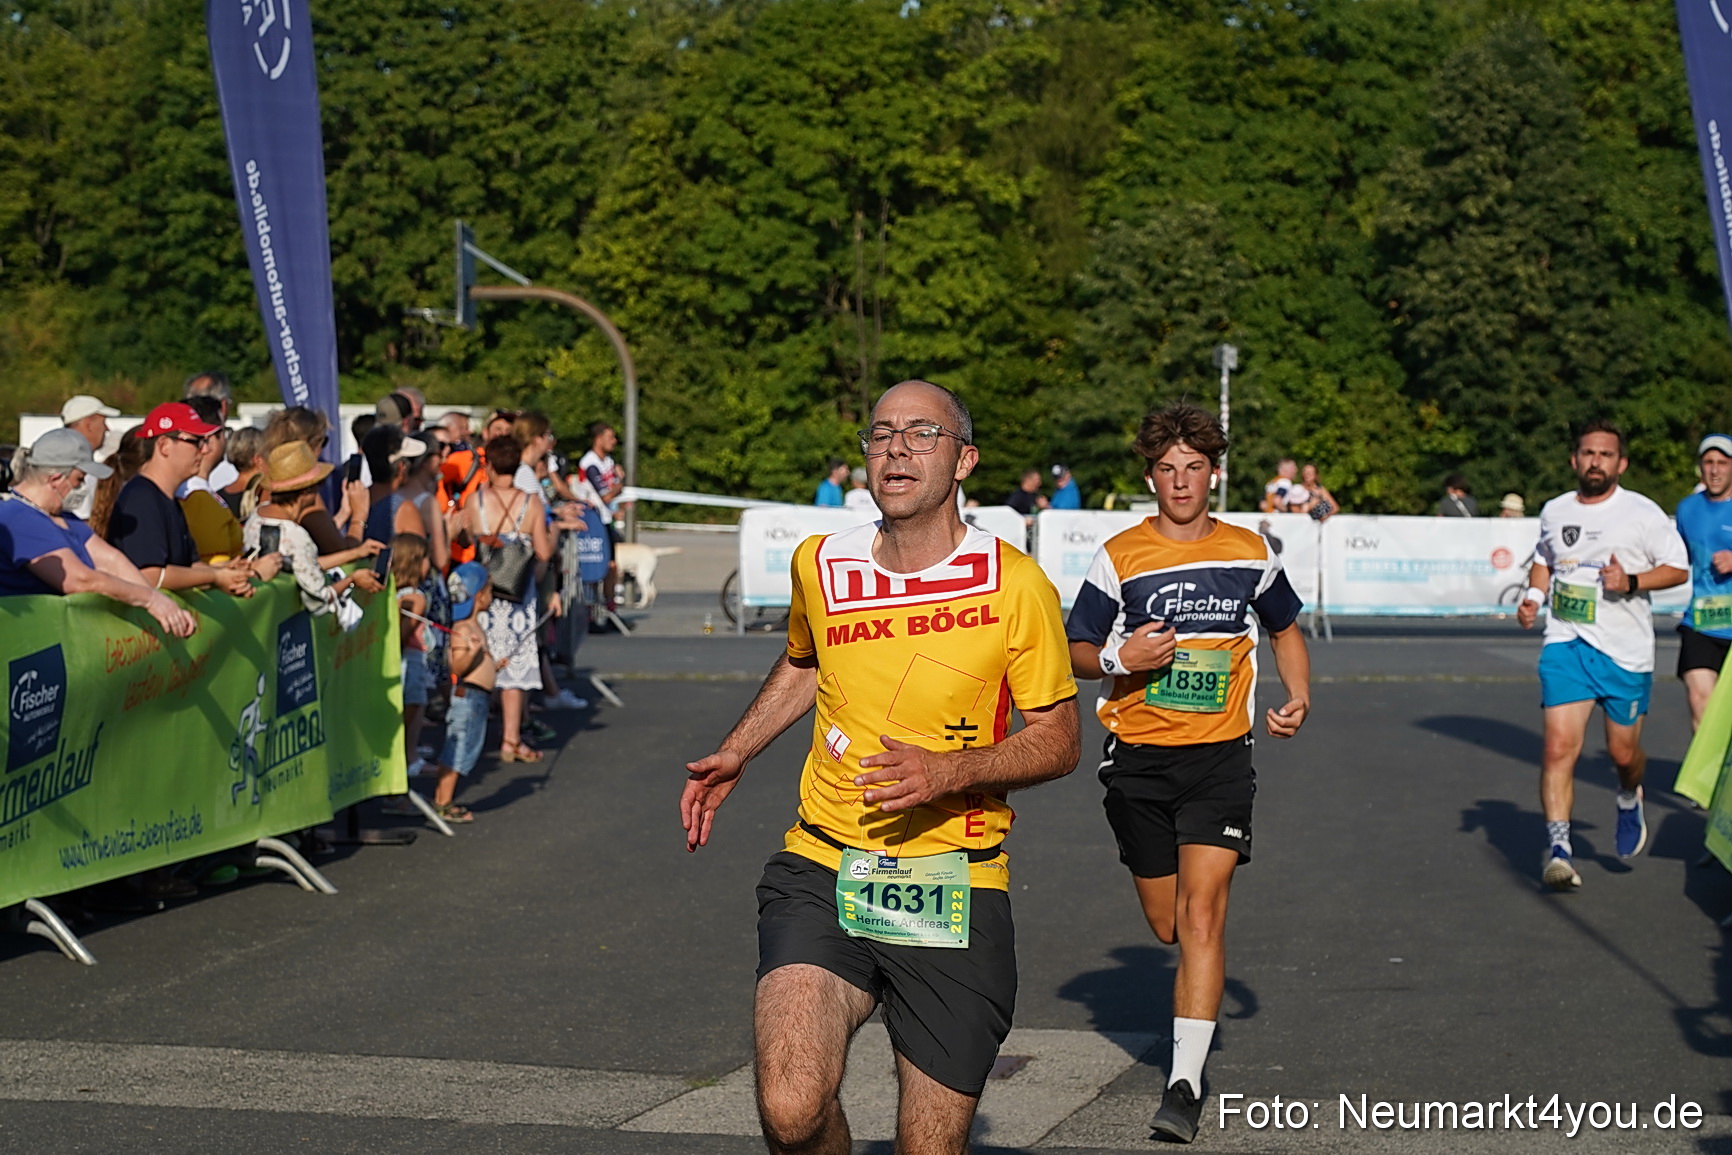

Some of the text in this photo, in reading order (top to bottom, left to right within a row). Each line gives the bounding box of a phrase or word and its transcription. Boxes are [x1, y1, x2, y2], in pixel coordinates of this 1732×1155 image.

[1164, 594, 1241, 616] Fischer
[1172, 613, 1237, 622] AUTOMOBILE
[826, 603, 1000, 648] MAX BÖGL
[1166, 670, 1217, 692] 1839
[1216, 675, 1227, 703] 2022
[19, 683, 60, 713] Fischer
[1160, 688, 1216, 701] Siebald Pascal
[1222, 825, 1243, 839] JAKO
[844, 891, 856, 921] RUN
[860, 882, 944, 915] 1631
[856, 915, 950, 929] Herrler Andreas
[950, 890, 964, 934] 2022
